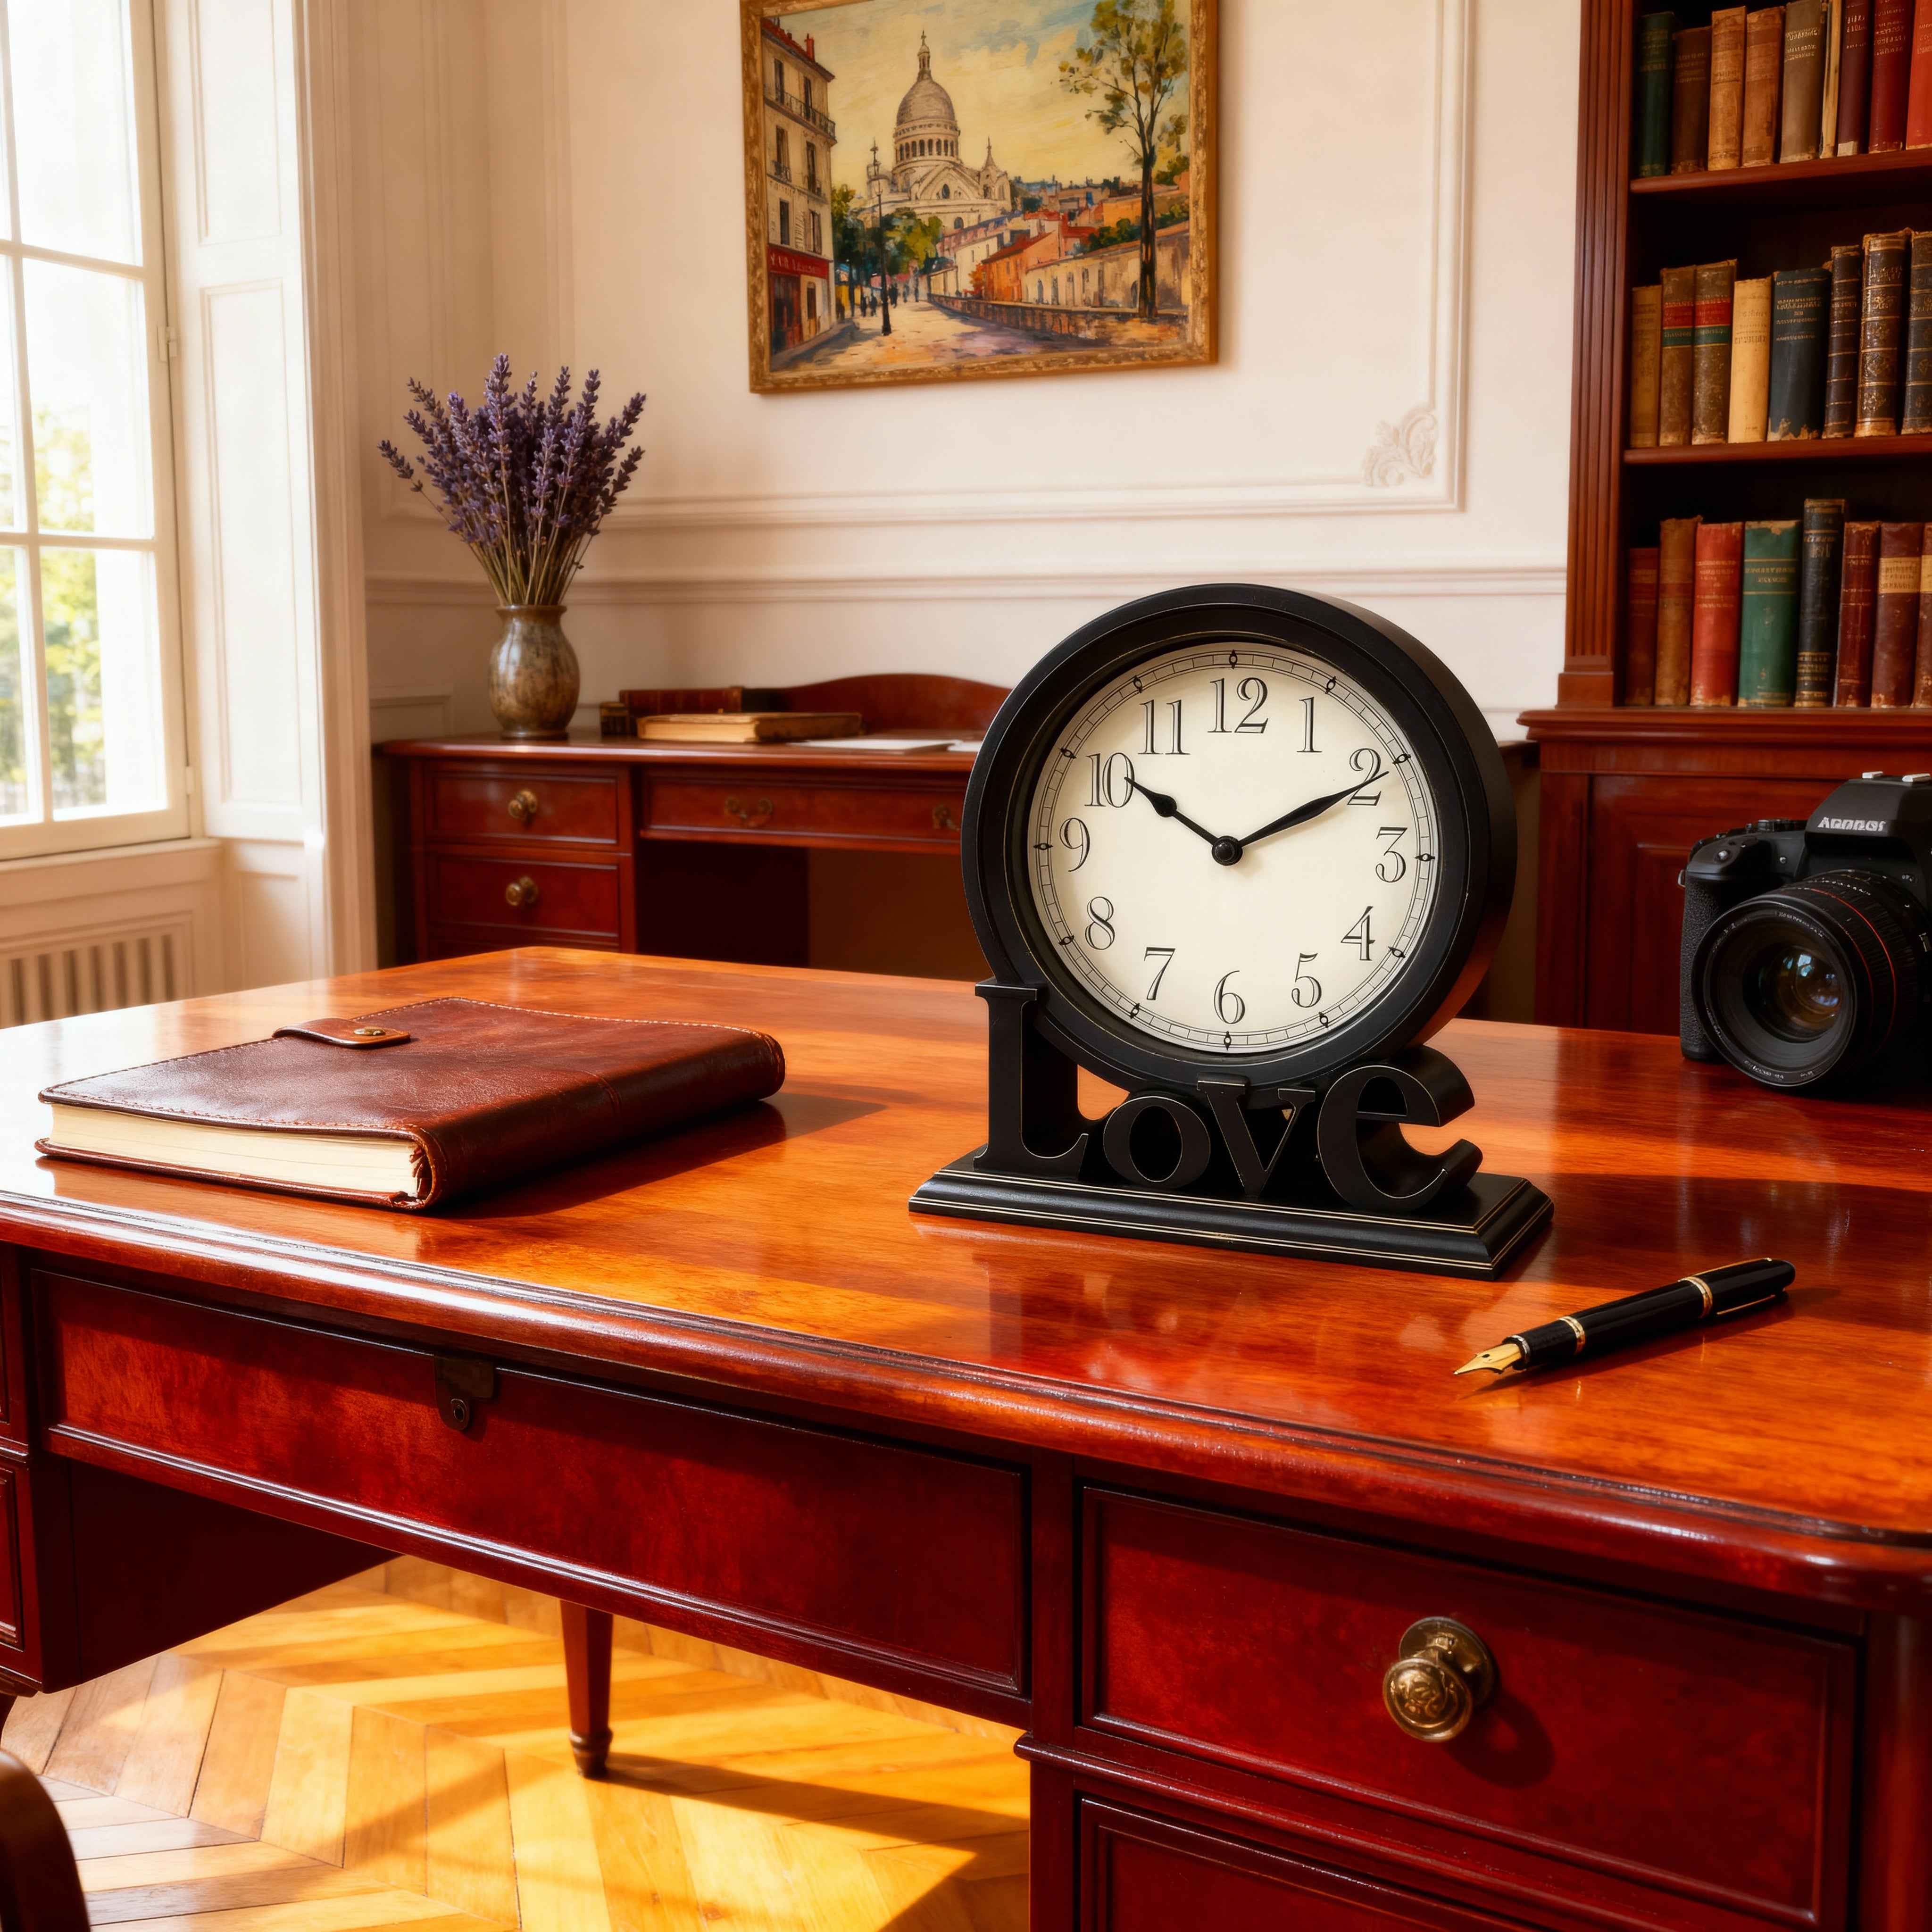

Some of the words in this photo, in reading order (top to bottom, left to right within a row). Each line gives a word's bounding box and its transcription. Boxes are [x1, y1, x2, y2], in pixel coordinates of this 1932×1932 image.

[1138, 700, 1190, 755] 11
[1208, 677, 1269, 734] 12
[1297, 697, 1323, 753] 1
[1084, 753, 1134, 808] 10
[1347, 748, 1382, 806] 2
[1059, 818, 1090, 872] 9
[1375, 827, 1407, 883] 3
[1085, 897, 1115, 950] 8
[1341, 906, 1375, 961] 4
[1144, 947, 1176, 1000] 7
[1214, 970, 1246, 1024] 6
[1291, 953, 1322, 1008] 5
